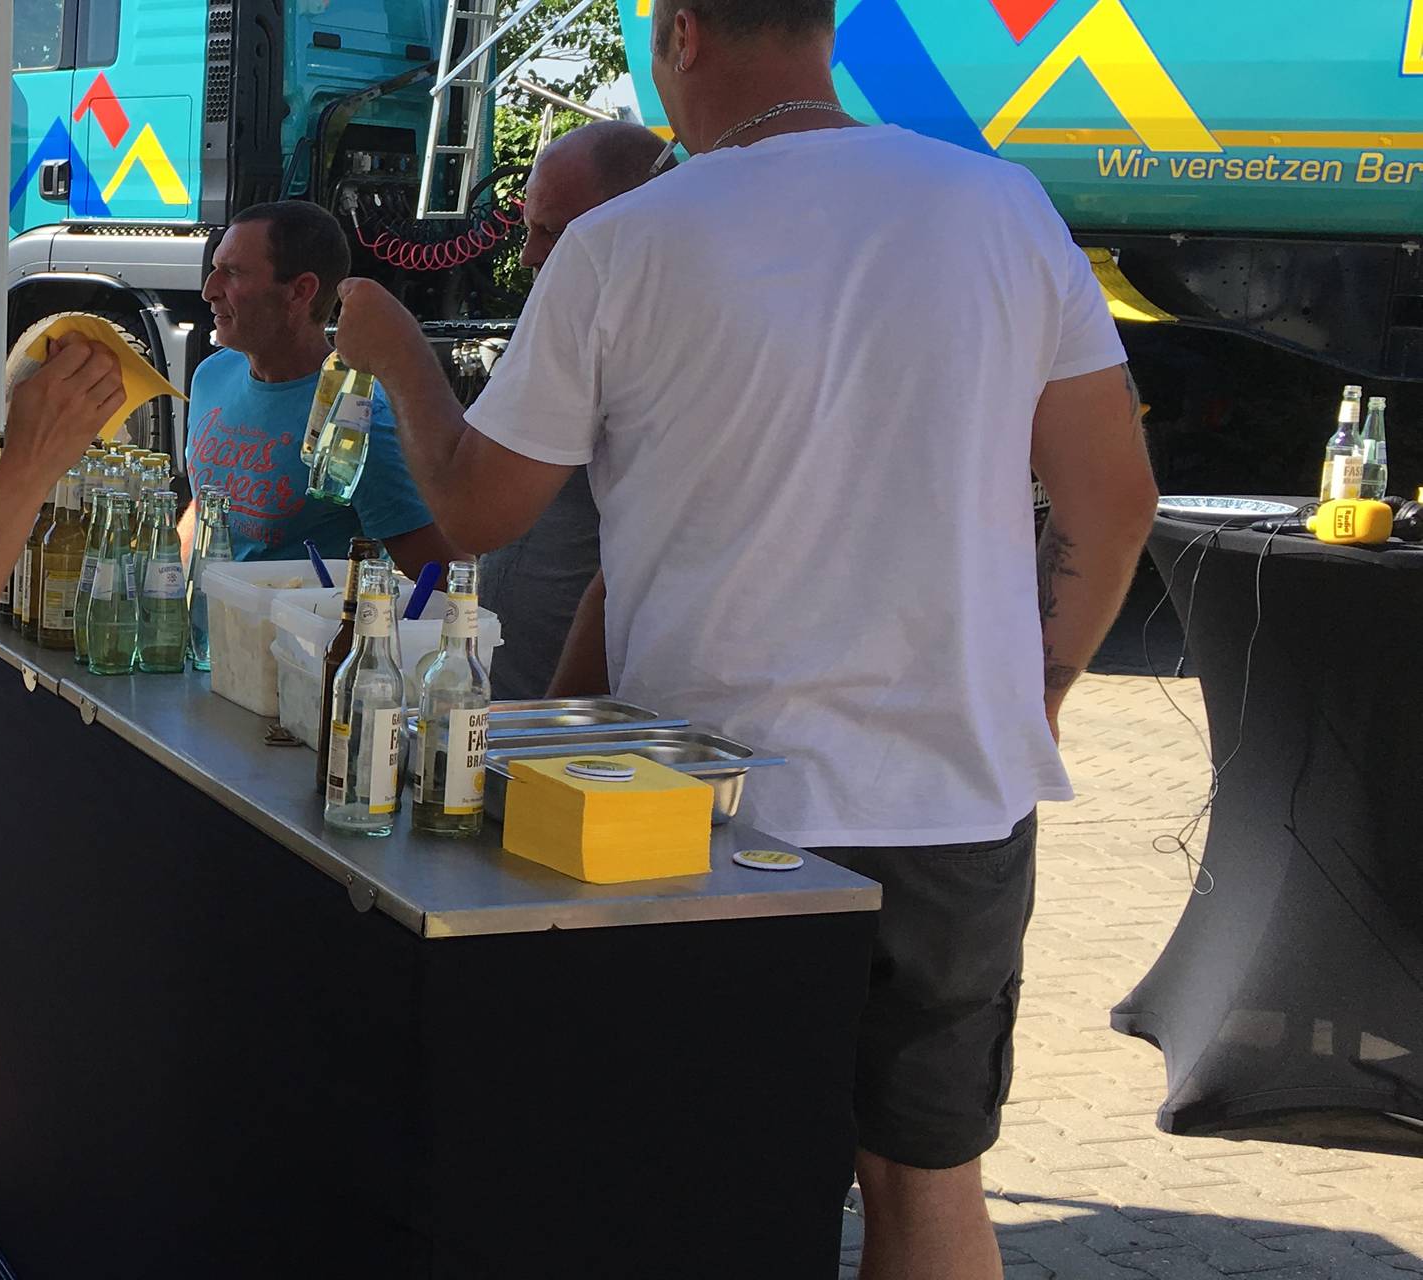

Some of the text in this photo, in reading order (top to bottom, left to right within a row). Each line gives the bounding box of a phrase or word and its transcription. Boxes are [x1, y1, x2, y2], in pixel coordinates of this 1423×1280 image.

[1097, 147, 1158, 178] Wir
[1169, 154, 1343, 183] versetzen
[187, 407, 278, 474] Jeans
